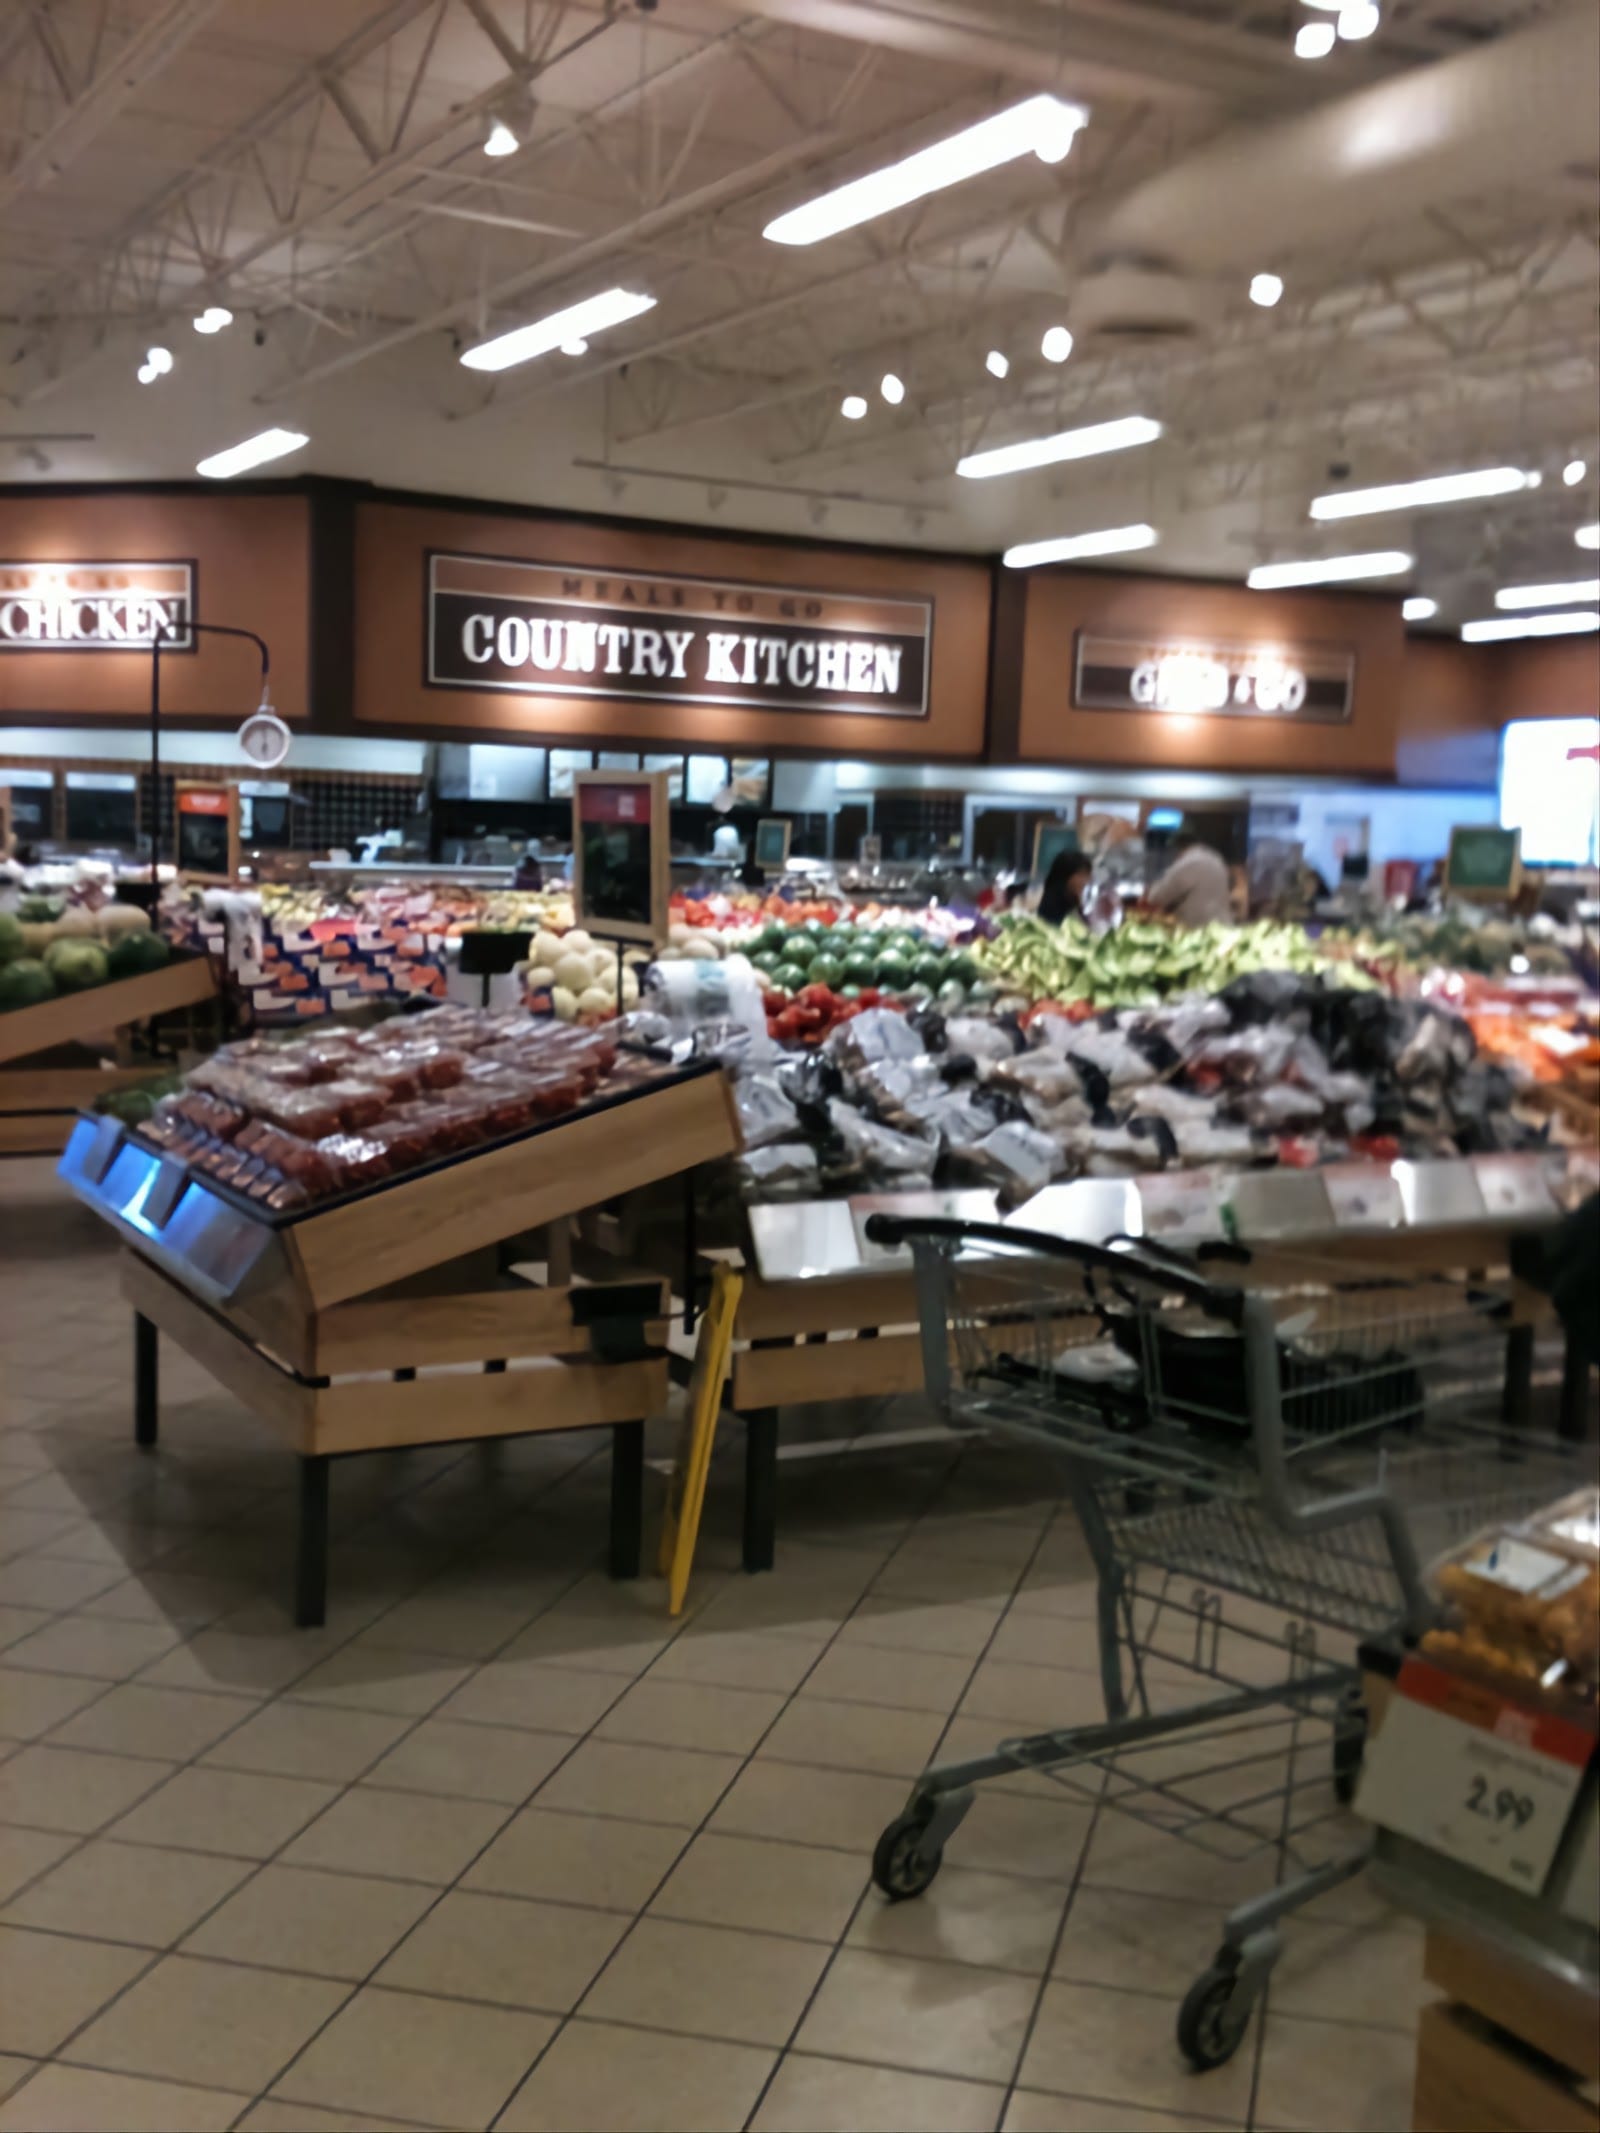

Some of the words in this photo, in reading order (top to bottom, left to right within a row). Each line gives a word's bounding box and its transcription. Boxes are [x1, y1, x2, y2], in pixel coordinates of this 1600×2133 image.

[1, 599, 177, 640] CHICKEN
[563, 577, 684, 607] MEALS
[712, 591, 754, 611] TO
[779, 599, 823, 619] GO
[462, 613, 695, 680] COUNTRY
[706, 631, 903, 695] KITCHEN
[1466, 1773, 1535, 1831] 2.99
